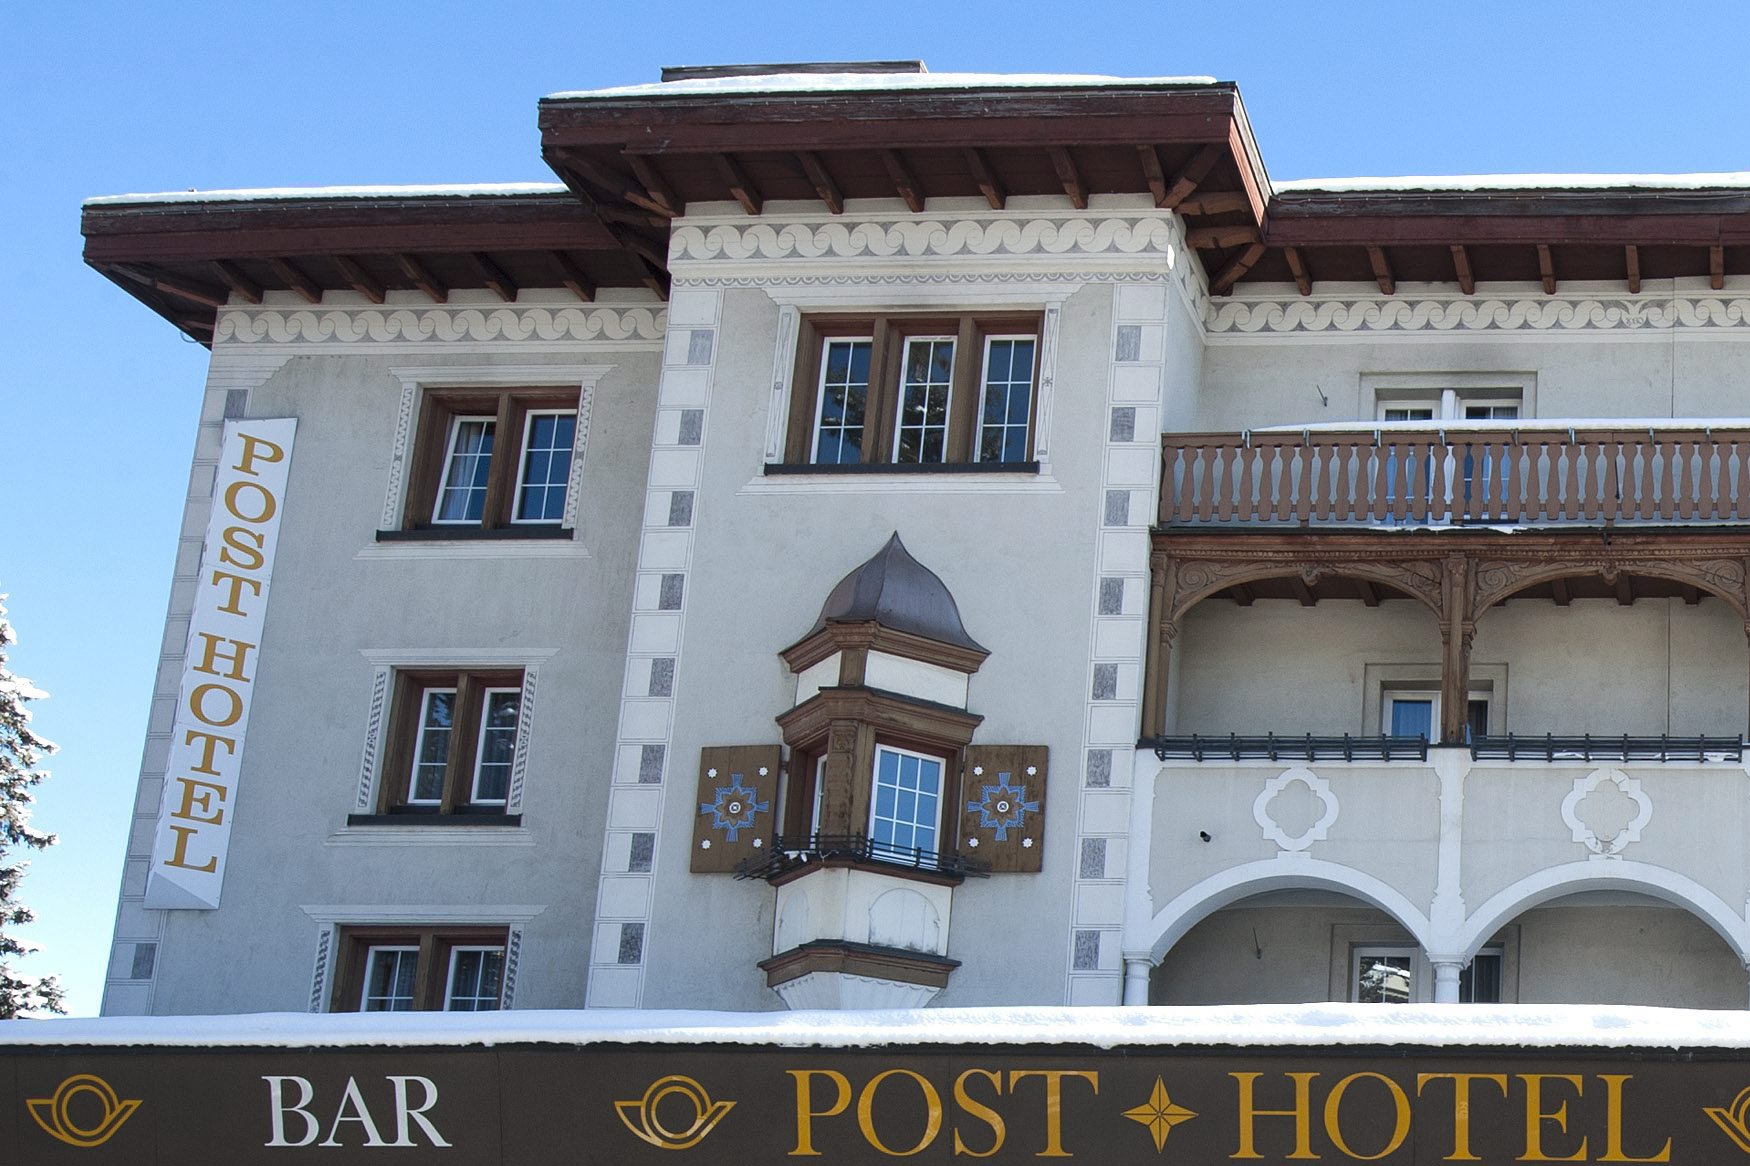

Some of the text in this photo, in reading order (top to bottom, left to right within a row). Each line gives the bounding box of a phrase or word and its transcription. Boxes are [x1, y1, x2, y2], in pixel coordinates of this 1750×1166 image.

[163, 432, 284, 874] POST HOTEL
[261, 1075, 453, 1148] BAR
[786, 1068, 1673, 1163] POST HOTEL
